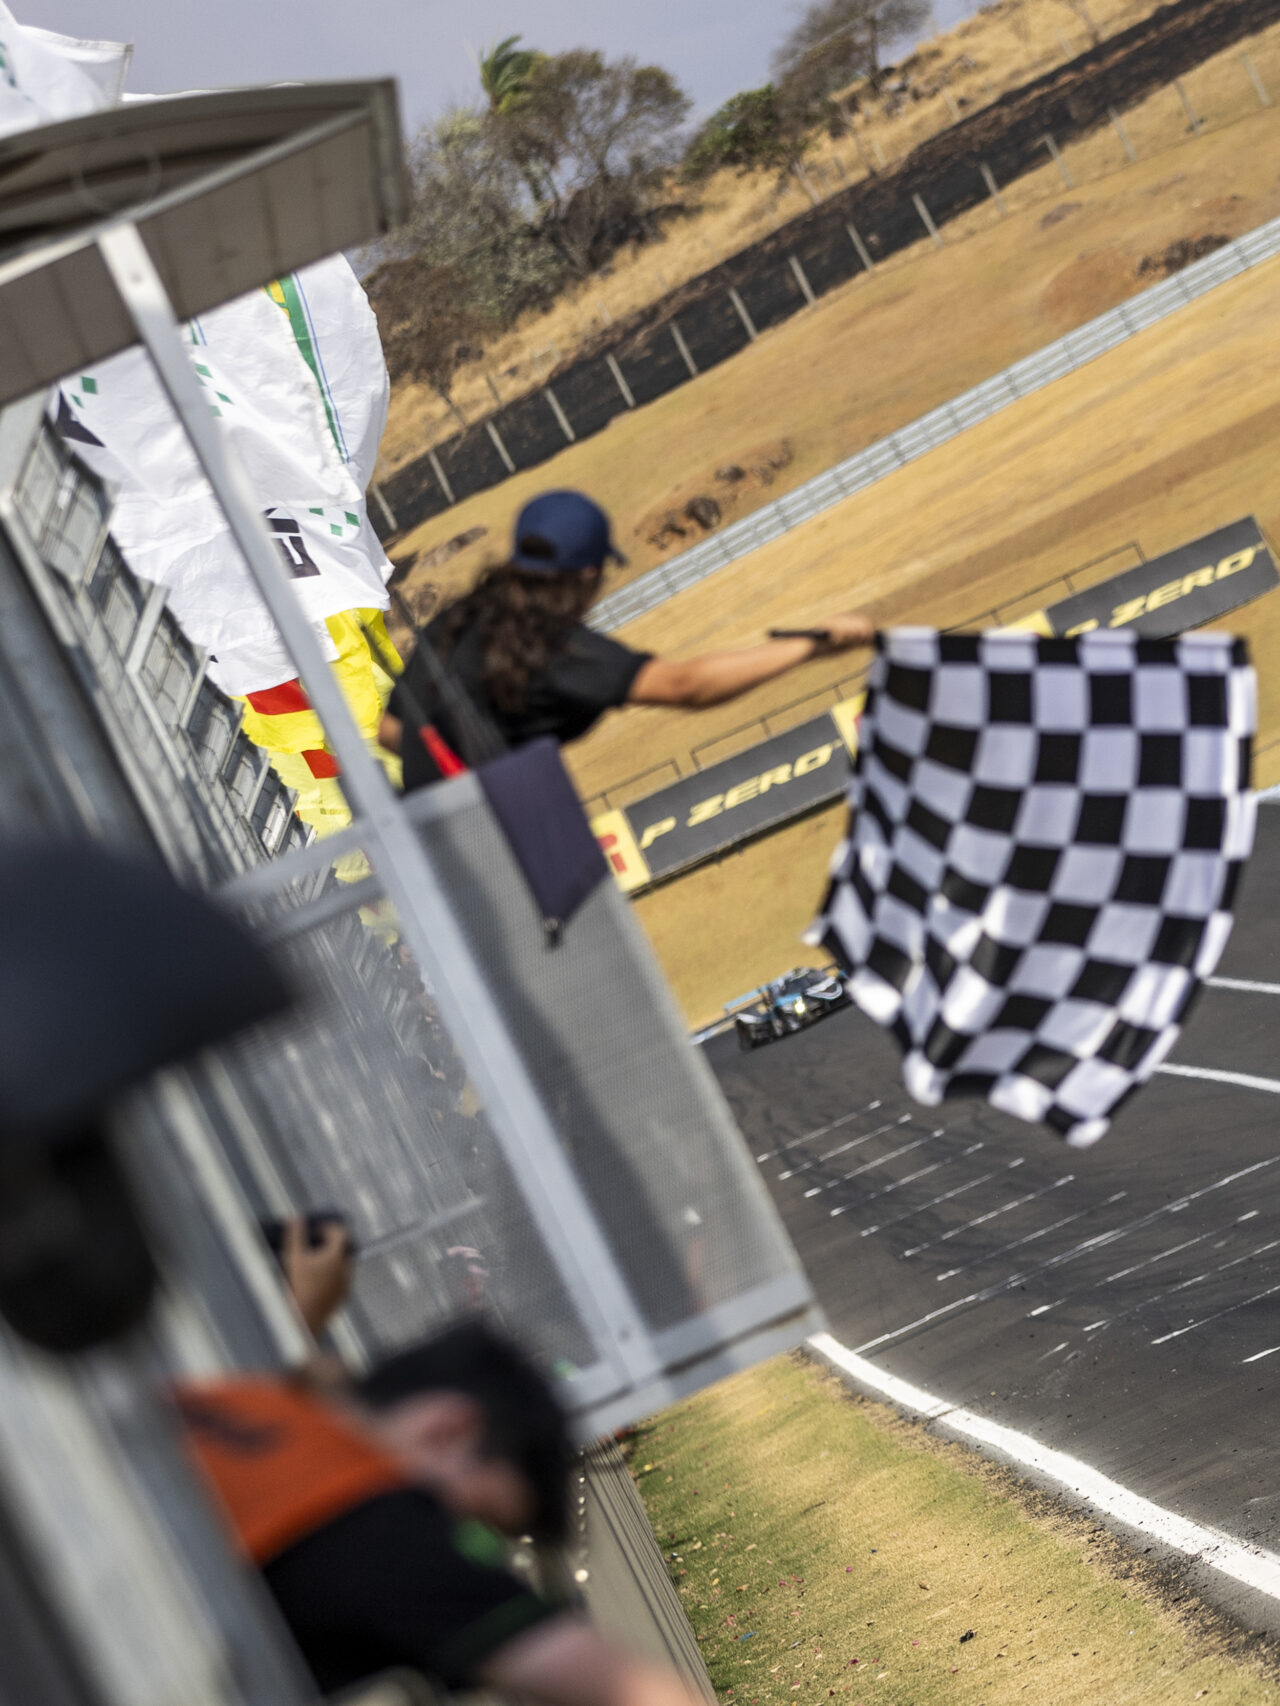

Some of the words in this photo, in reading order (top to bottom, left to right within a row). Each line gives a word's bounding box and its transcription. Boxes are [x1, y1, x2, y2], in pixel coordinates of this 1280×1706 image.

[1109, 546, 1256, 629] ZERO
[640, 816, 677, 850] P
[687, 743, 833, 828] ZERO
